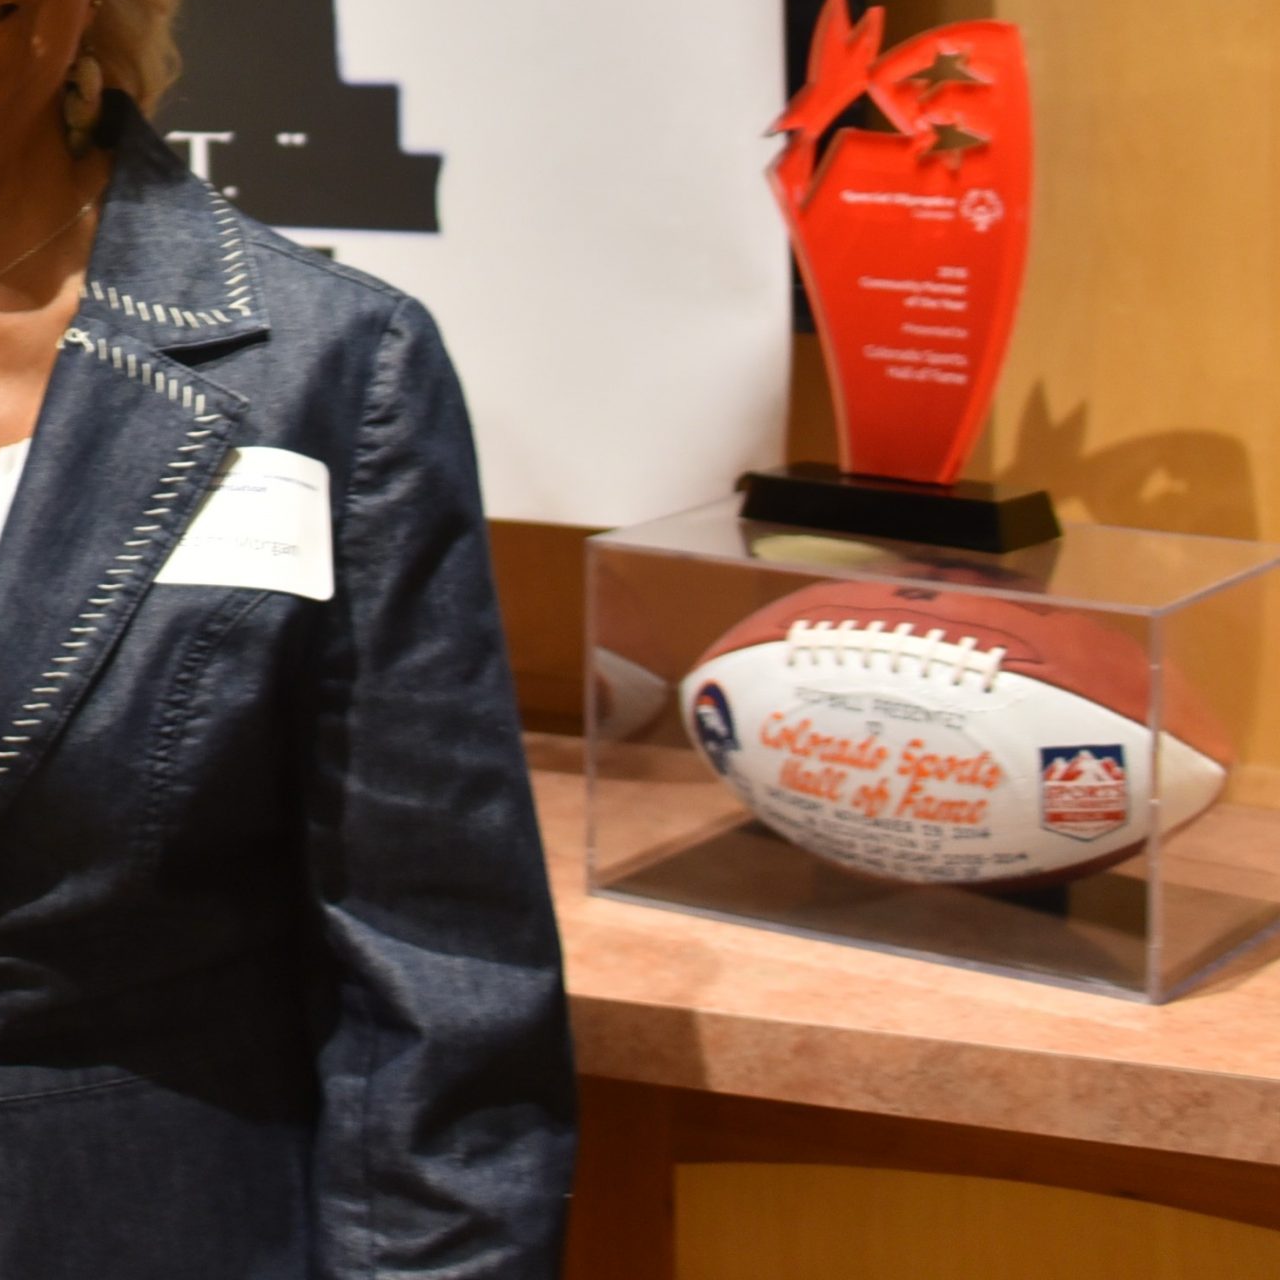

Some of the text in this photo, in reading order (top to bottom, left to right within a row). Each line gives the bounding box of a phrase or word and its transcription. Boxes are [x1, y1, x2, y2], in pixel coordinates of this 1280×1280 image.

[759, 711, 1005, 792] Colorado Sports
[779, 758, 989, 824] Hall of Fame
